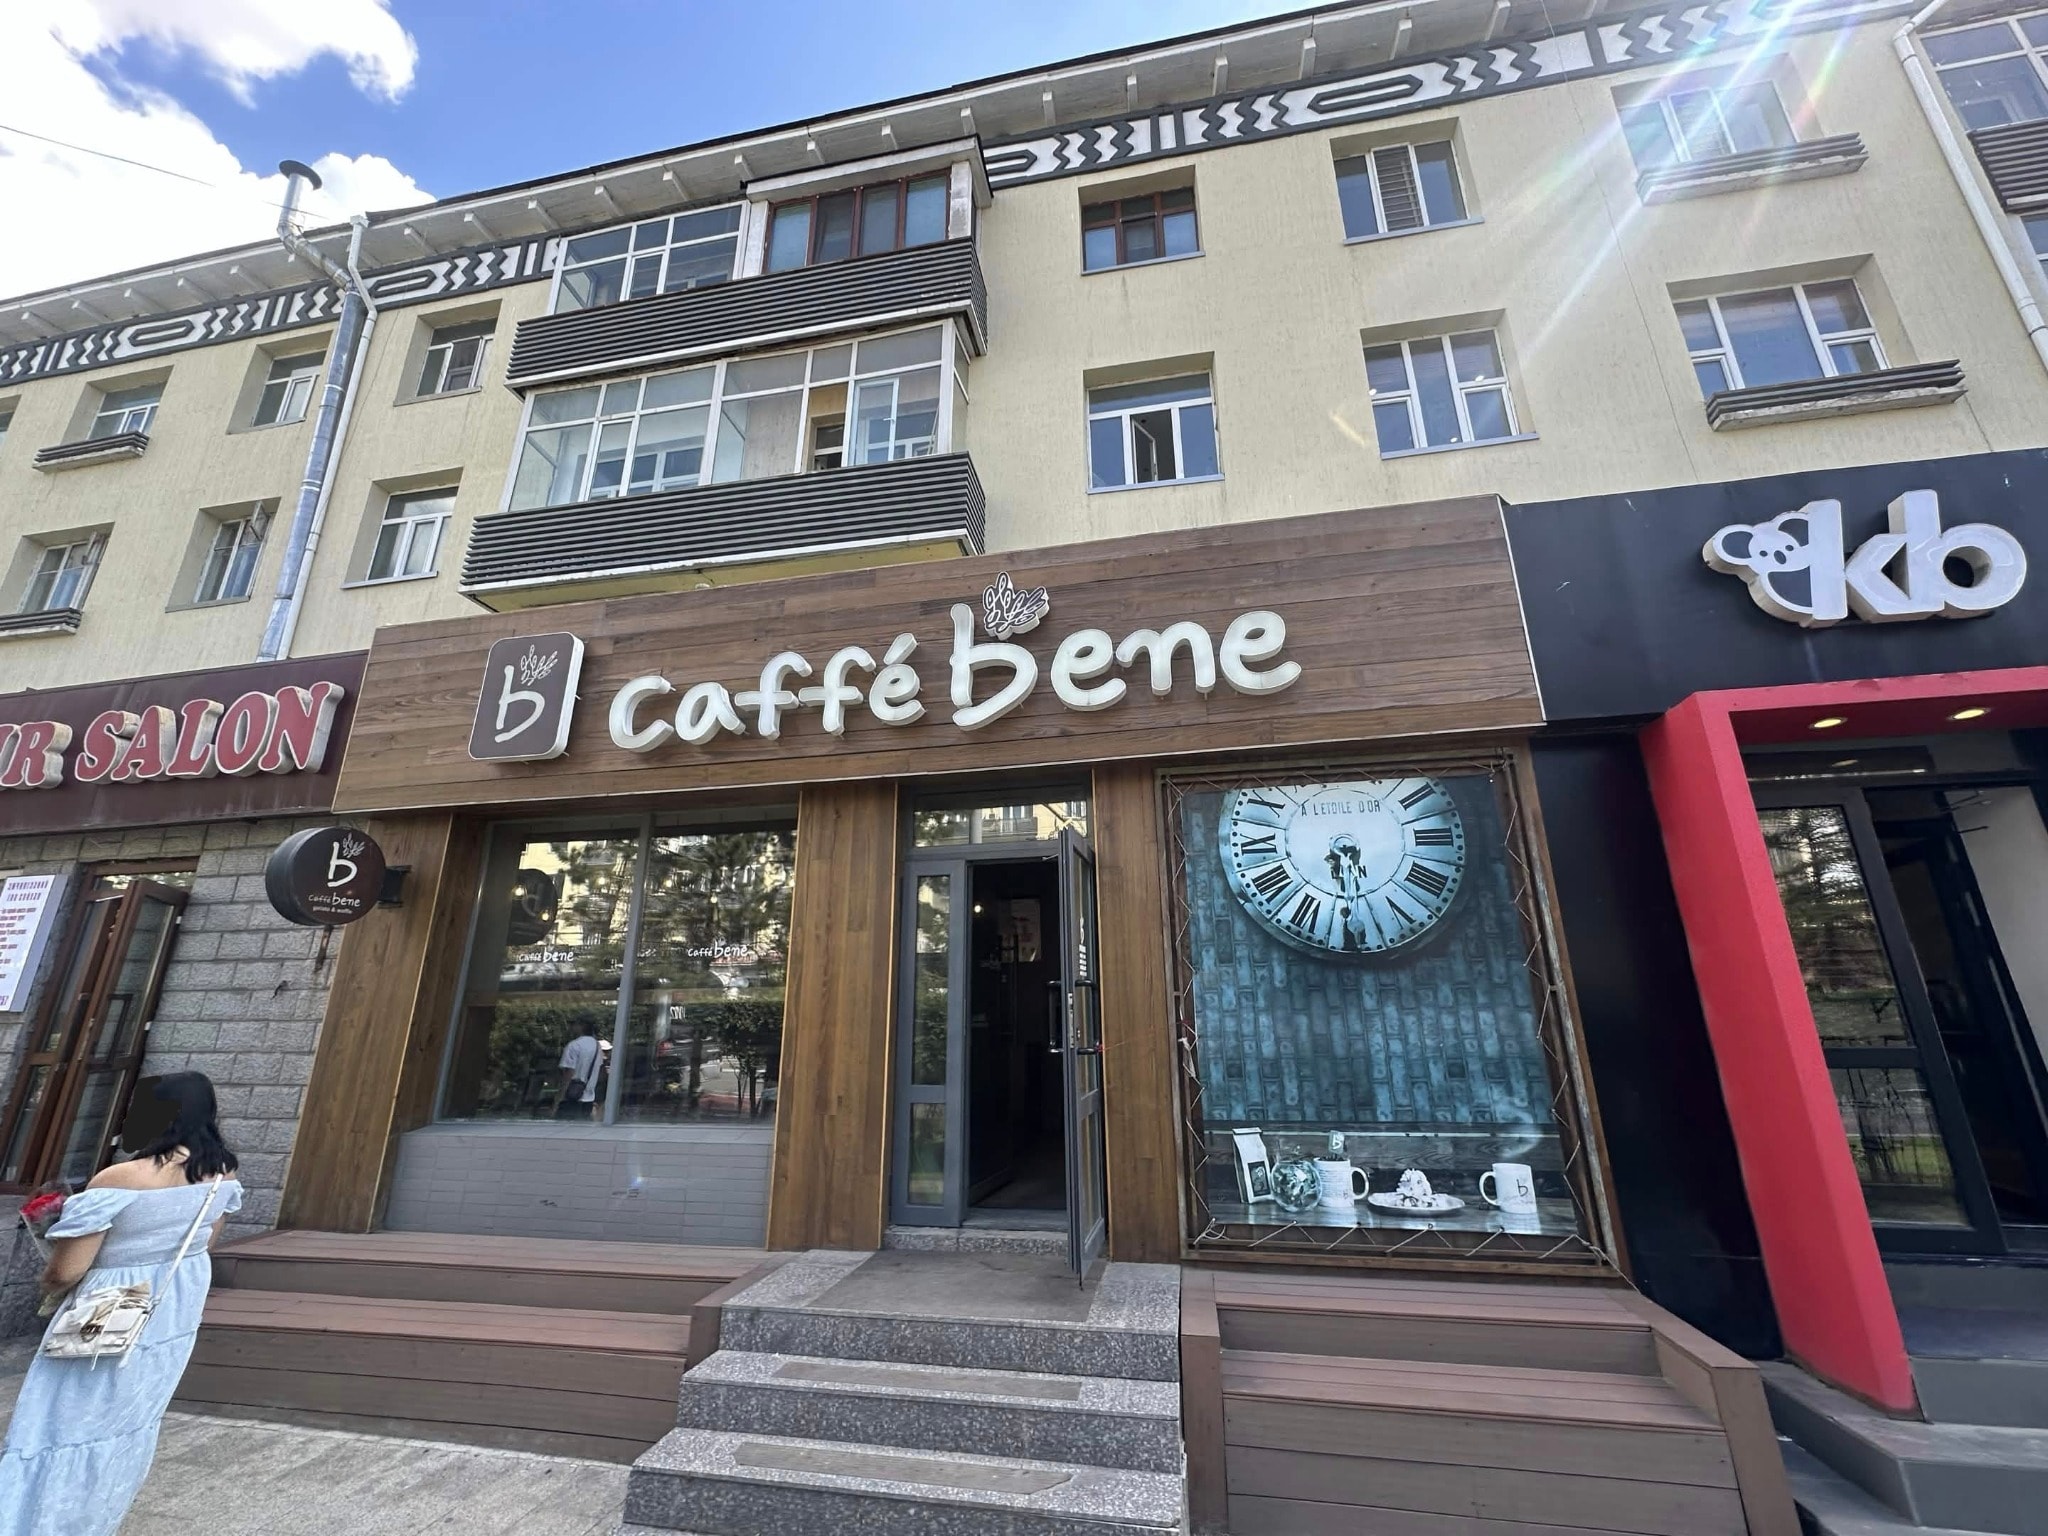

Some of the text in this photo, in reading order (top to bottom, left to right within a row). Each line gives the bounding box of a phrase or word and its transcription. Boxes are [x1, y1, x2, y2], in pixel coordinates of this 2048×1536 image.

[608, 602, 1302, 753] caffé bene
[74, 680, 346, 785] SALON
[332, 891, 361, 907] bene
[543, 946, 574, 963] bene
[713, 940, 748, 959] bene
